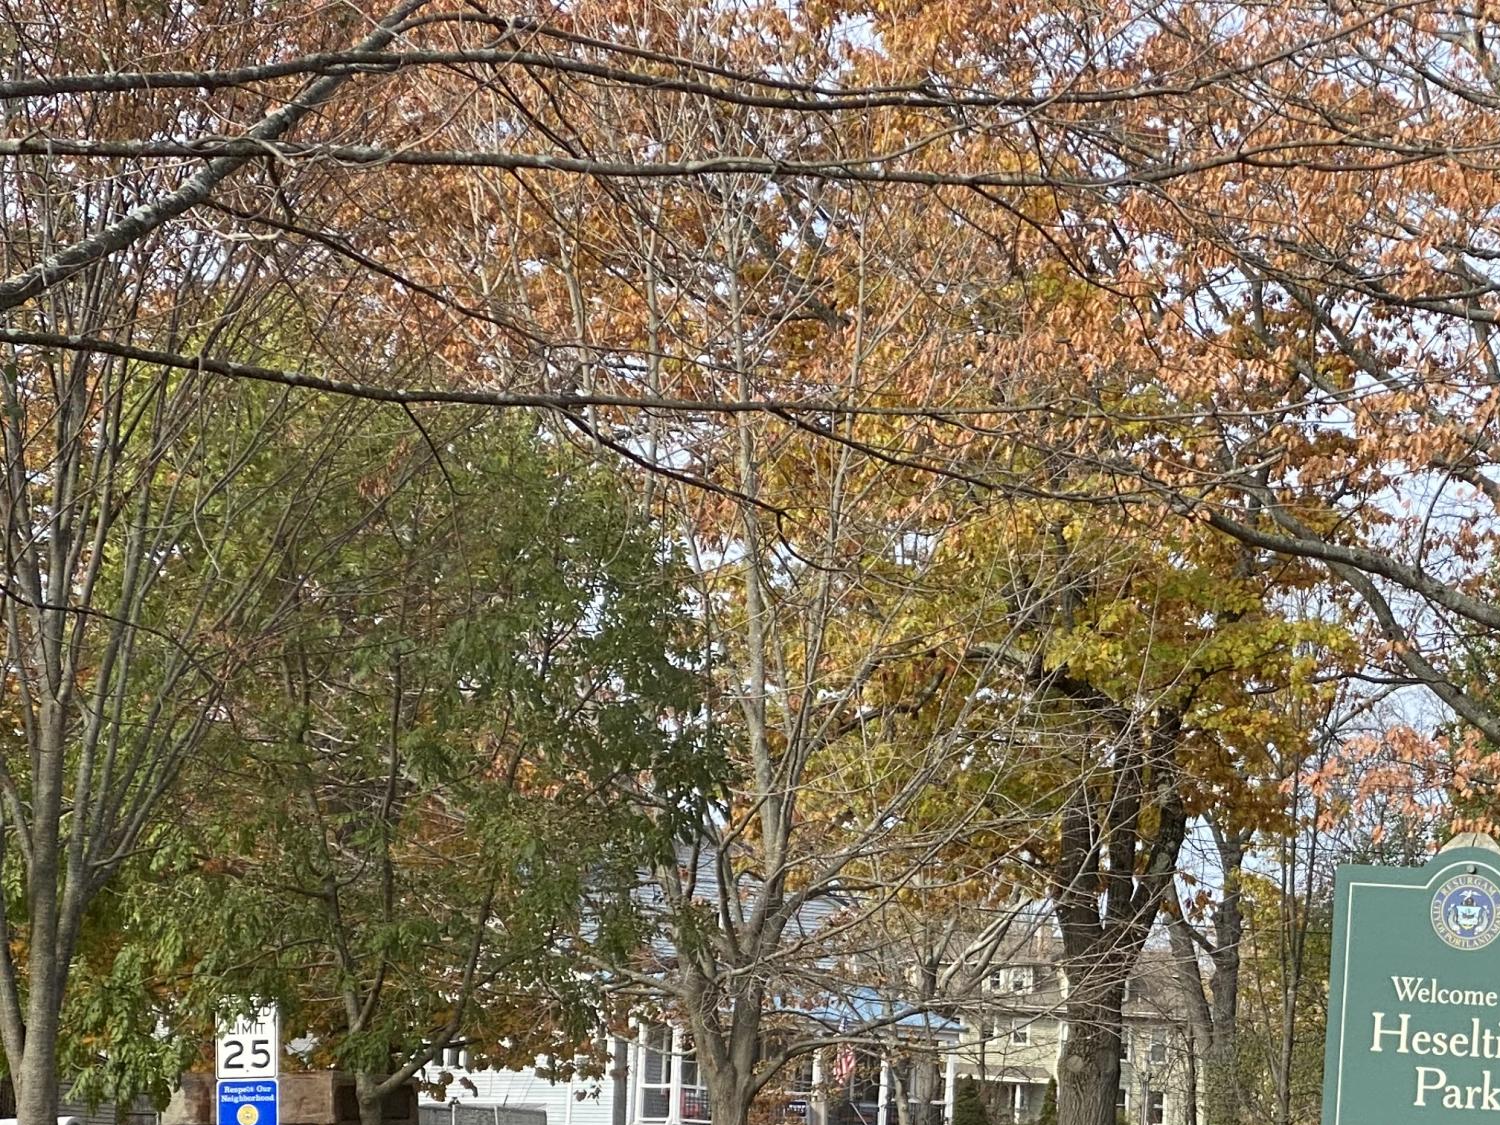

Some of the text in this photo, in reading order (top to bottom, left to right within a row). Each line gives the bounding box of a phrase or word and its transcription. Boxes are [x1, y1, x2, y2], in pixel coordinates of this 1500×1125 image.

[1440, 877, 1497, 897] RESURGAM
[1433, 900, 1441, 920] CITY
[1391, 976, 1498, 1006] Welcome
[224, 1040, 271, 1069] 25
[221, 1094, 275, 1104] Neighborhood
[224, 1085, 272, 1095] Respect Our
